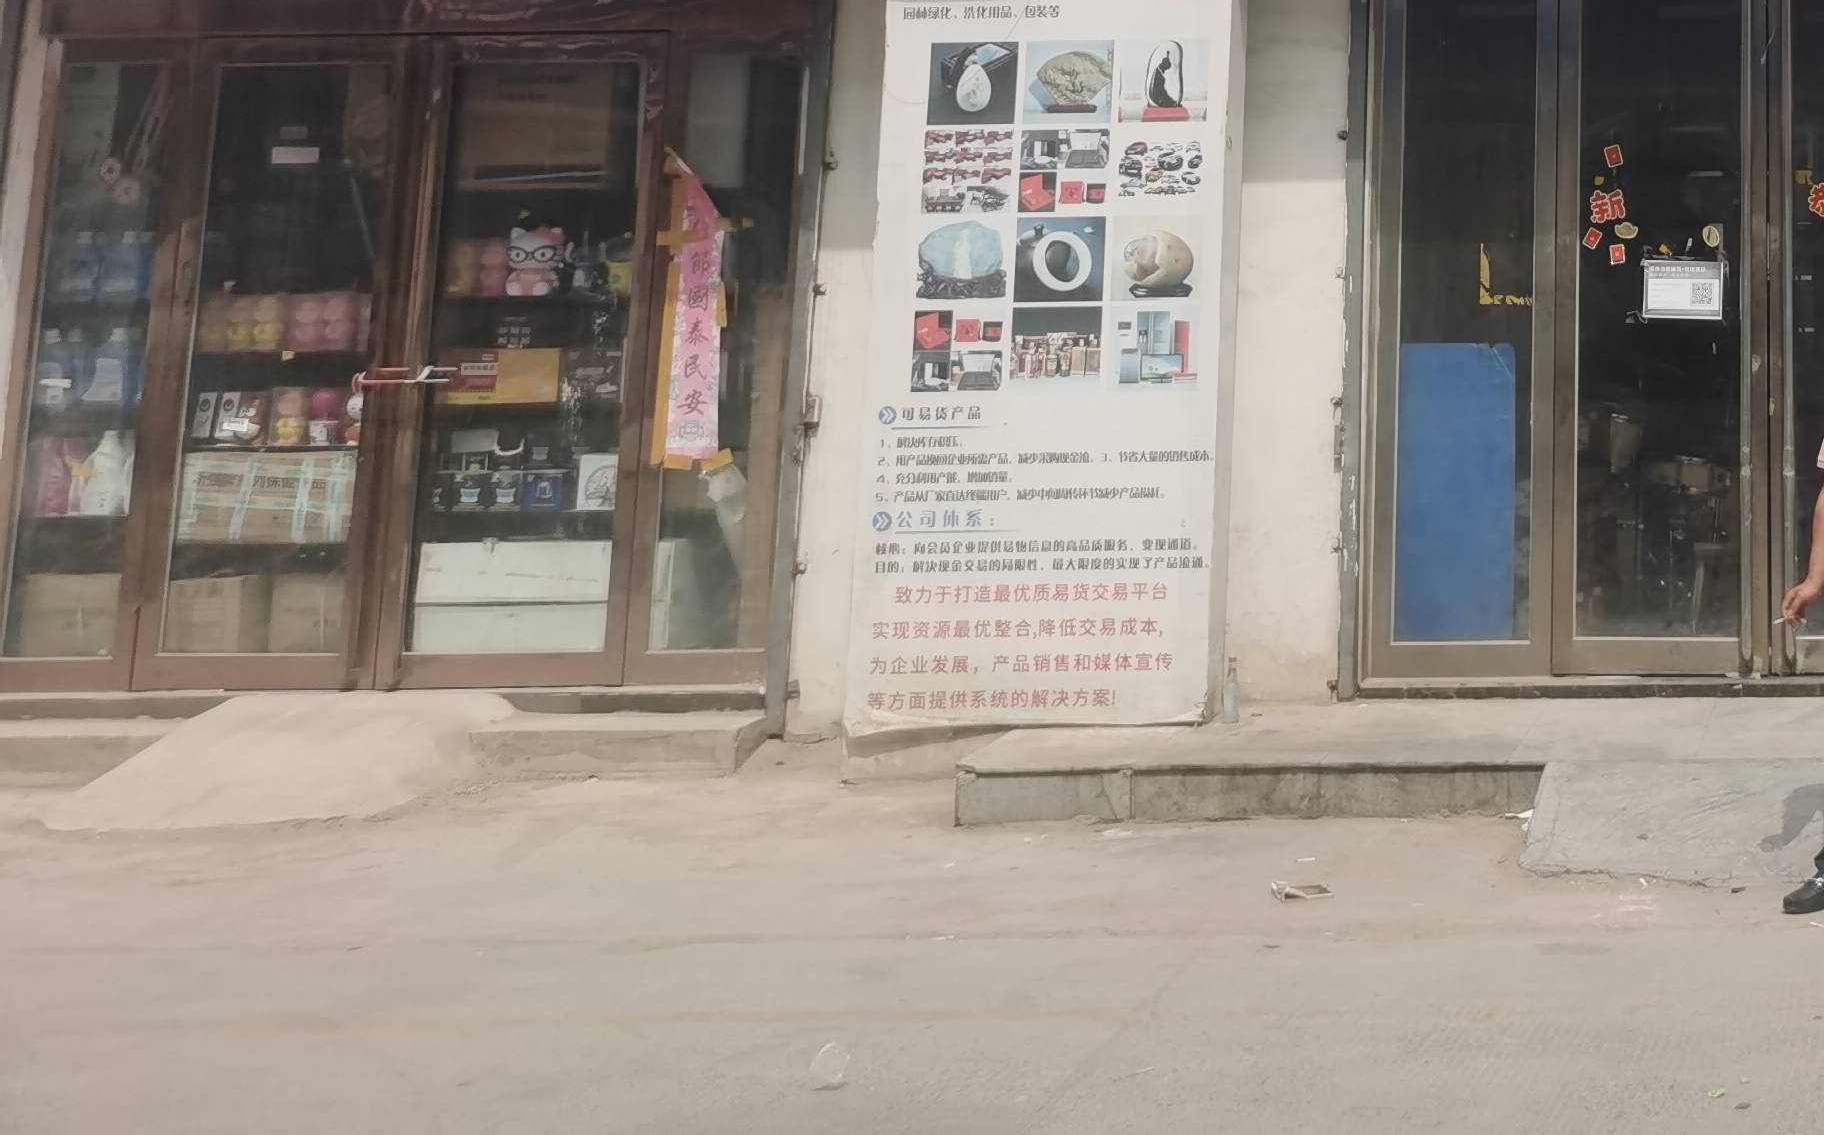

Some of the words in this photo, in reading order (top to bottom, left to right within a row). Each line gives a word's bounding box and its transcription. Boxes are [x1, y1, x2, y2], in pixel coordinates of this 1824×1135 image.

[894, 582, 1169, 605] 致力于打造最优质易货交易平台
